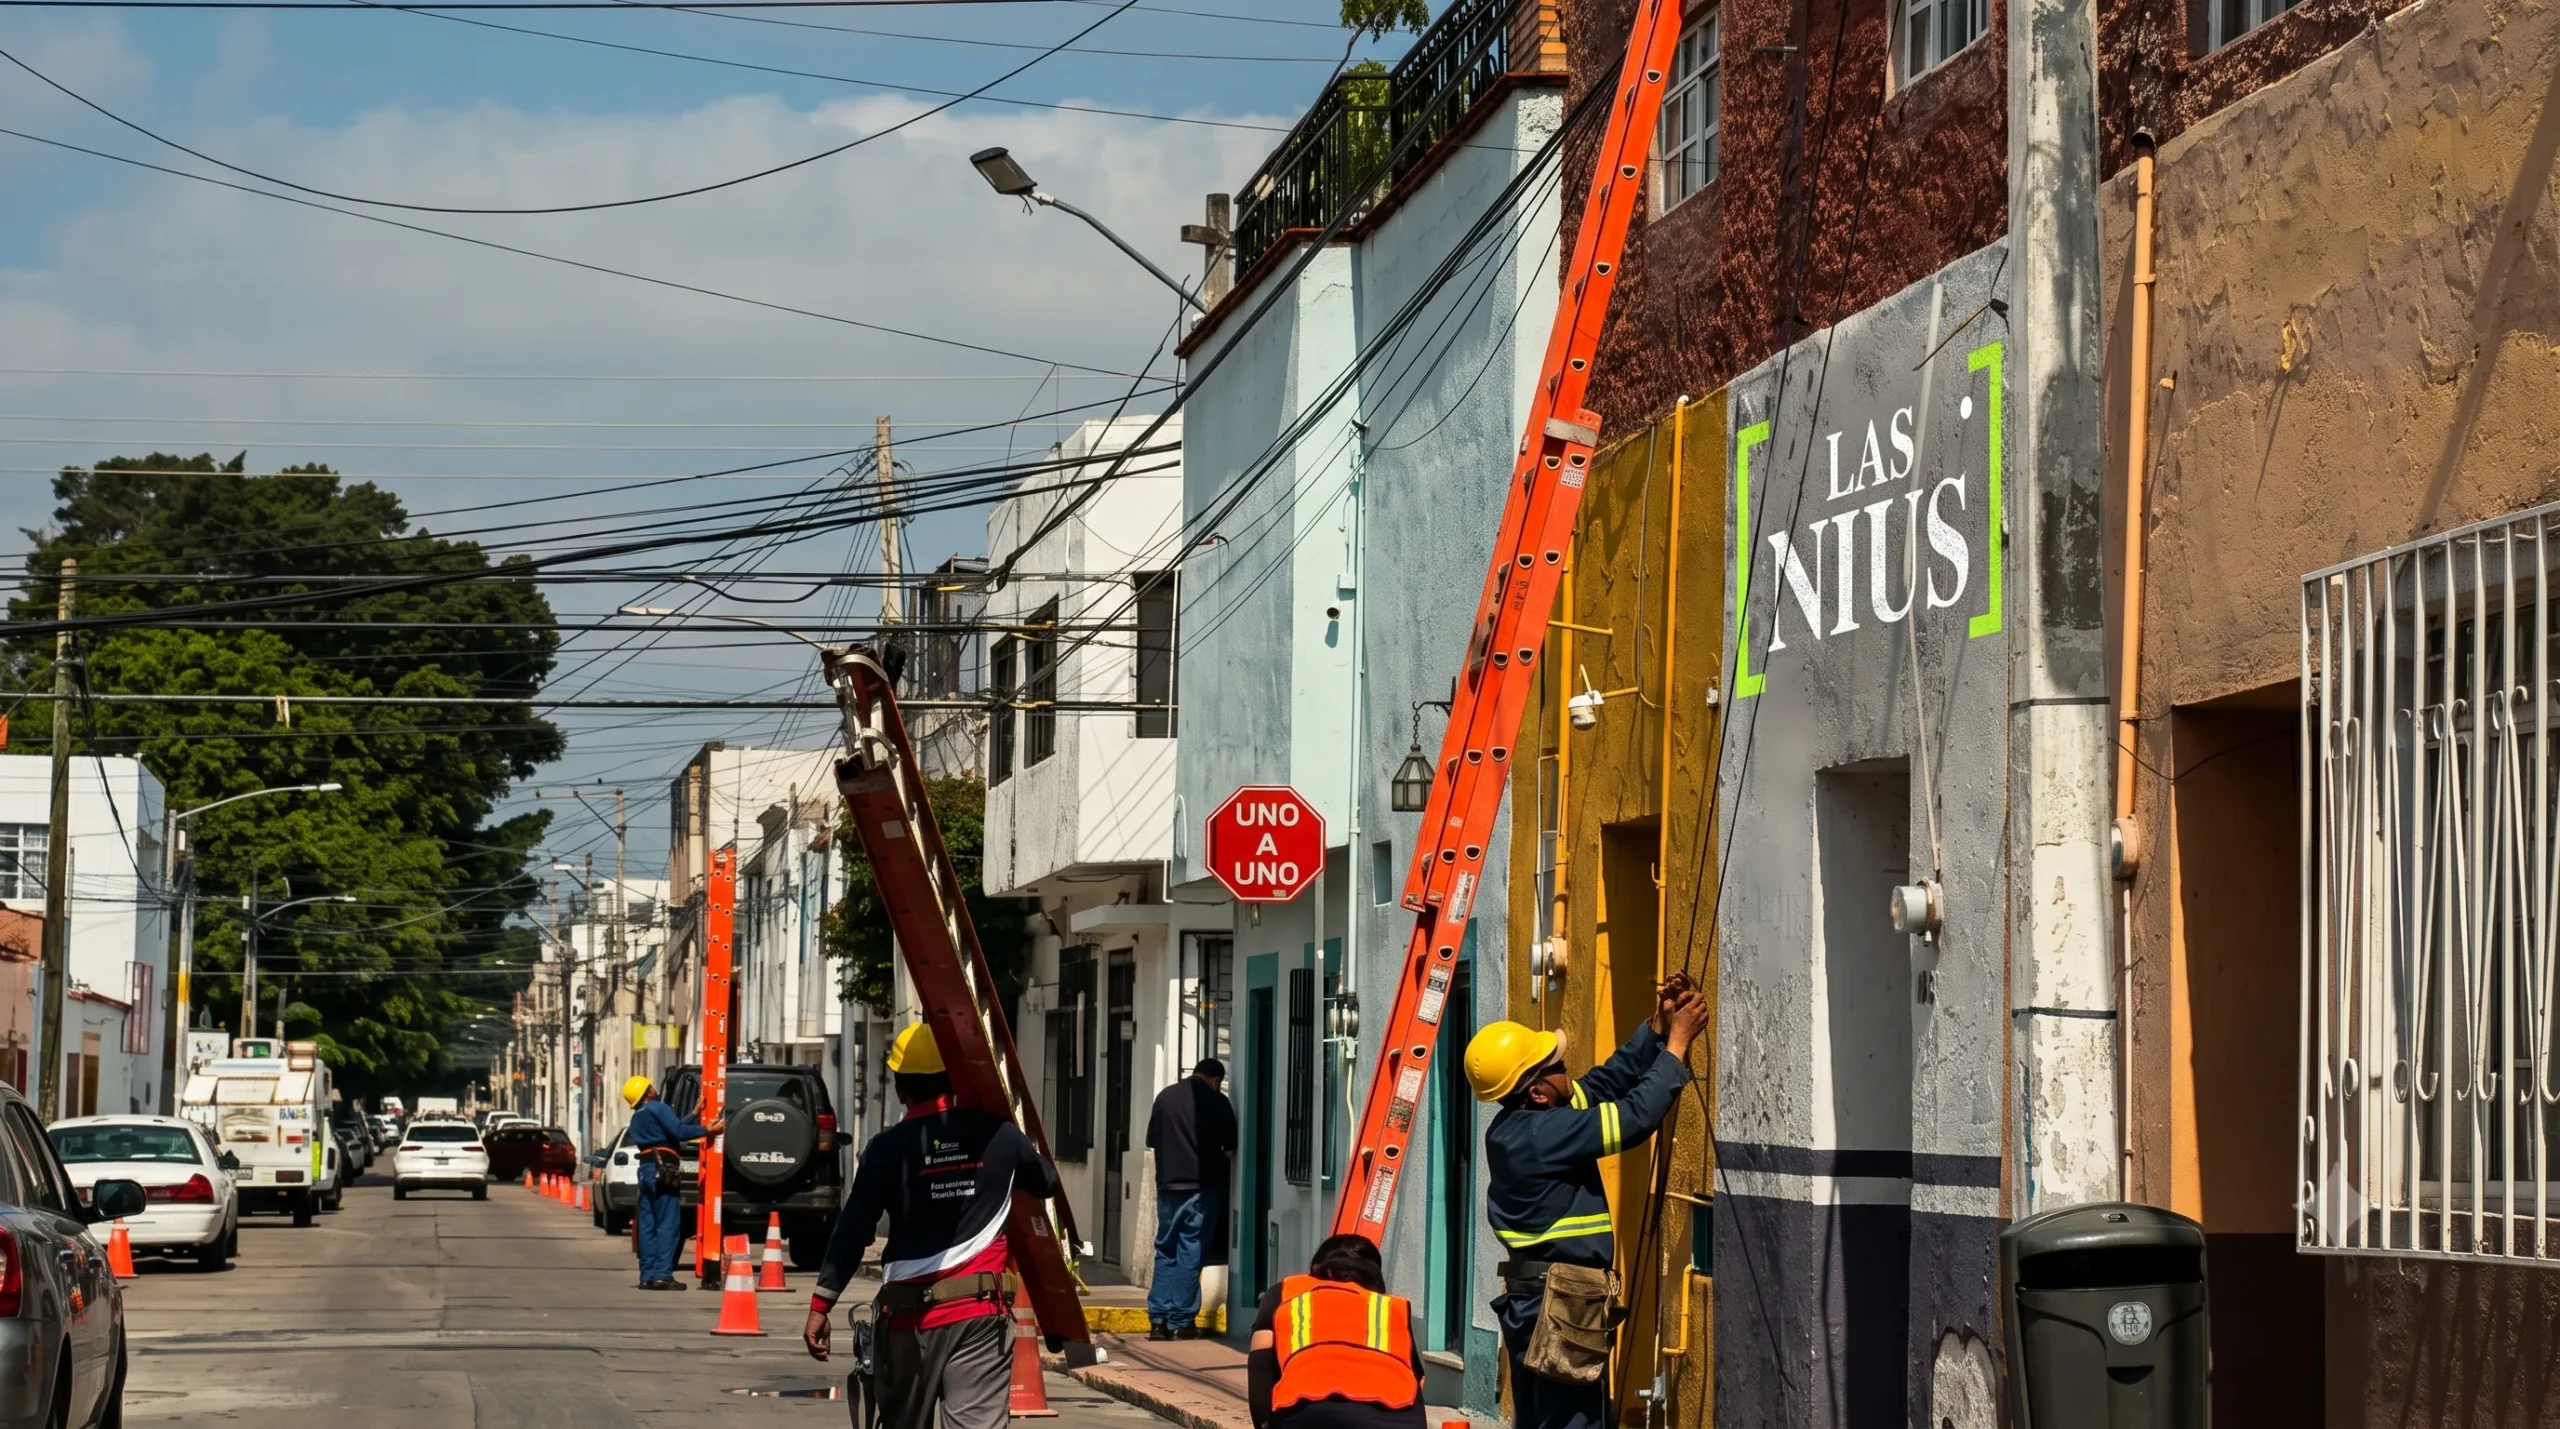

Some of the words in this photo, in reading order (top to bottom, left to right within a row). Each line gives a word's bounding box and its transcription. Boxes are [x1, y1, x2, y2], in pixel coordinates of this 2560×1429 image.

[1826, 405, 1914, 502] LAS
[1768, 470, 1970, 653] NIUS
[1236, 802, 1300, 827] UNO
[1255, 832, 1278, 856] A
[1234, 861, 1299, 886] UNO
